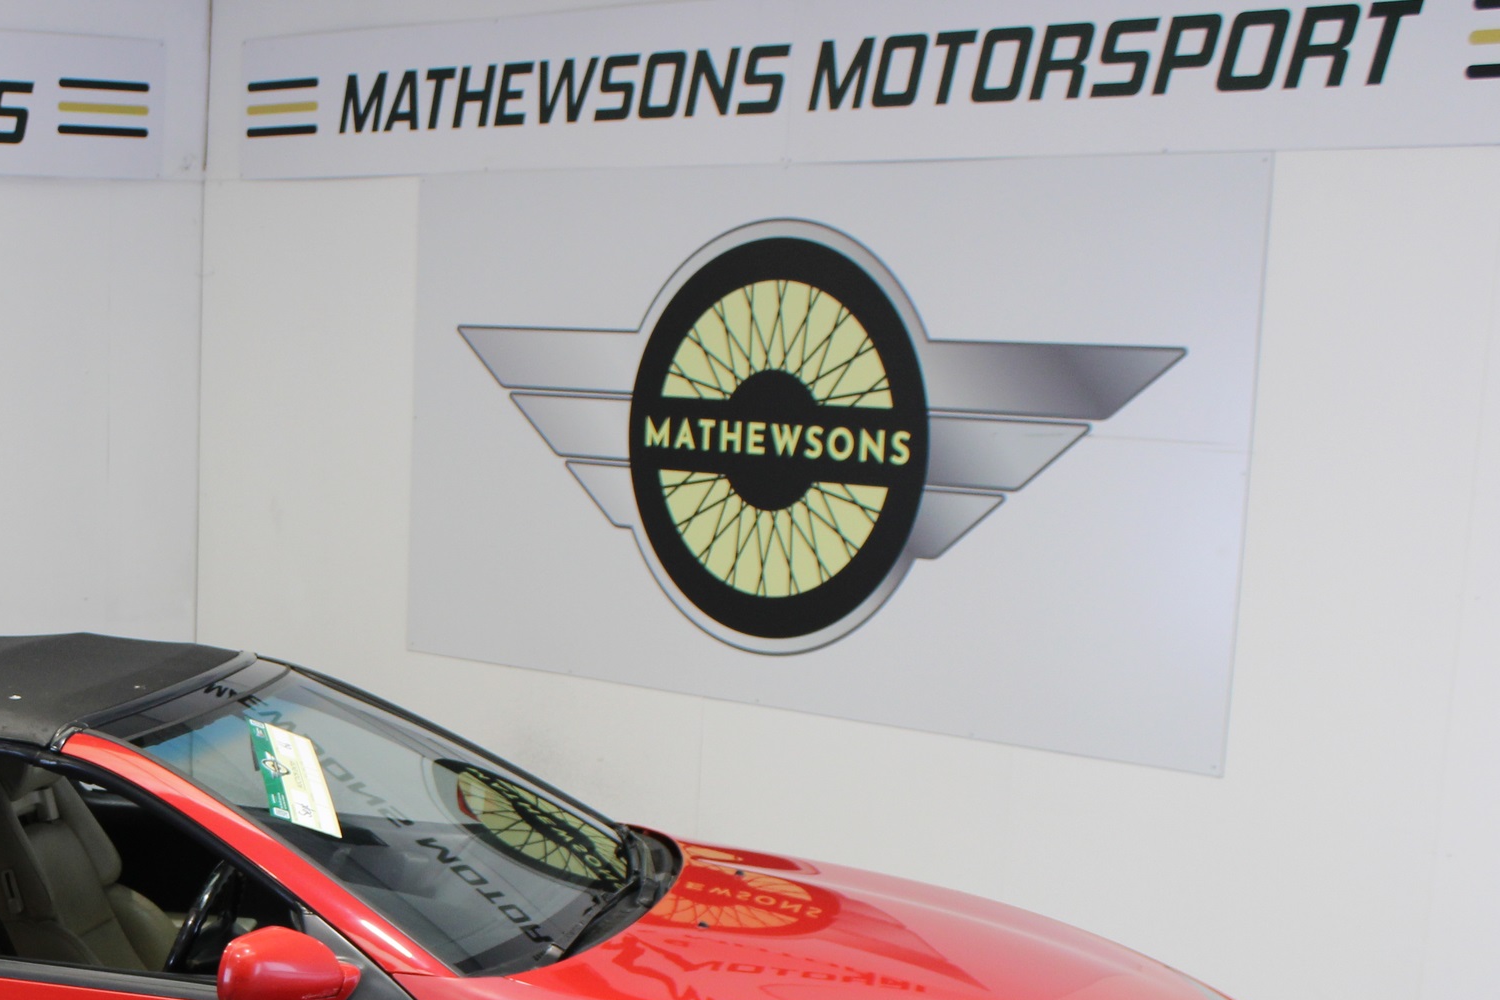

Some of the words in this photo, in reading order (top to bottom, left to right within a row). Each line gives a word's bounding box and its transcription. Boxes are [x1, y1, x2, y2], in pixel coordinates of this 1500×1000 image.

[339, 44, 792, 134] MATHEWSONS
[808, 0, 1425, 112] MOTORSPORT
[644, 416, 912, 465] MATHEWSONS
